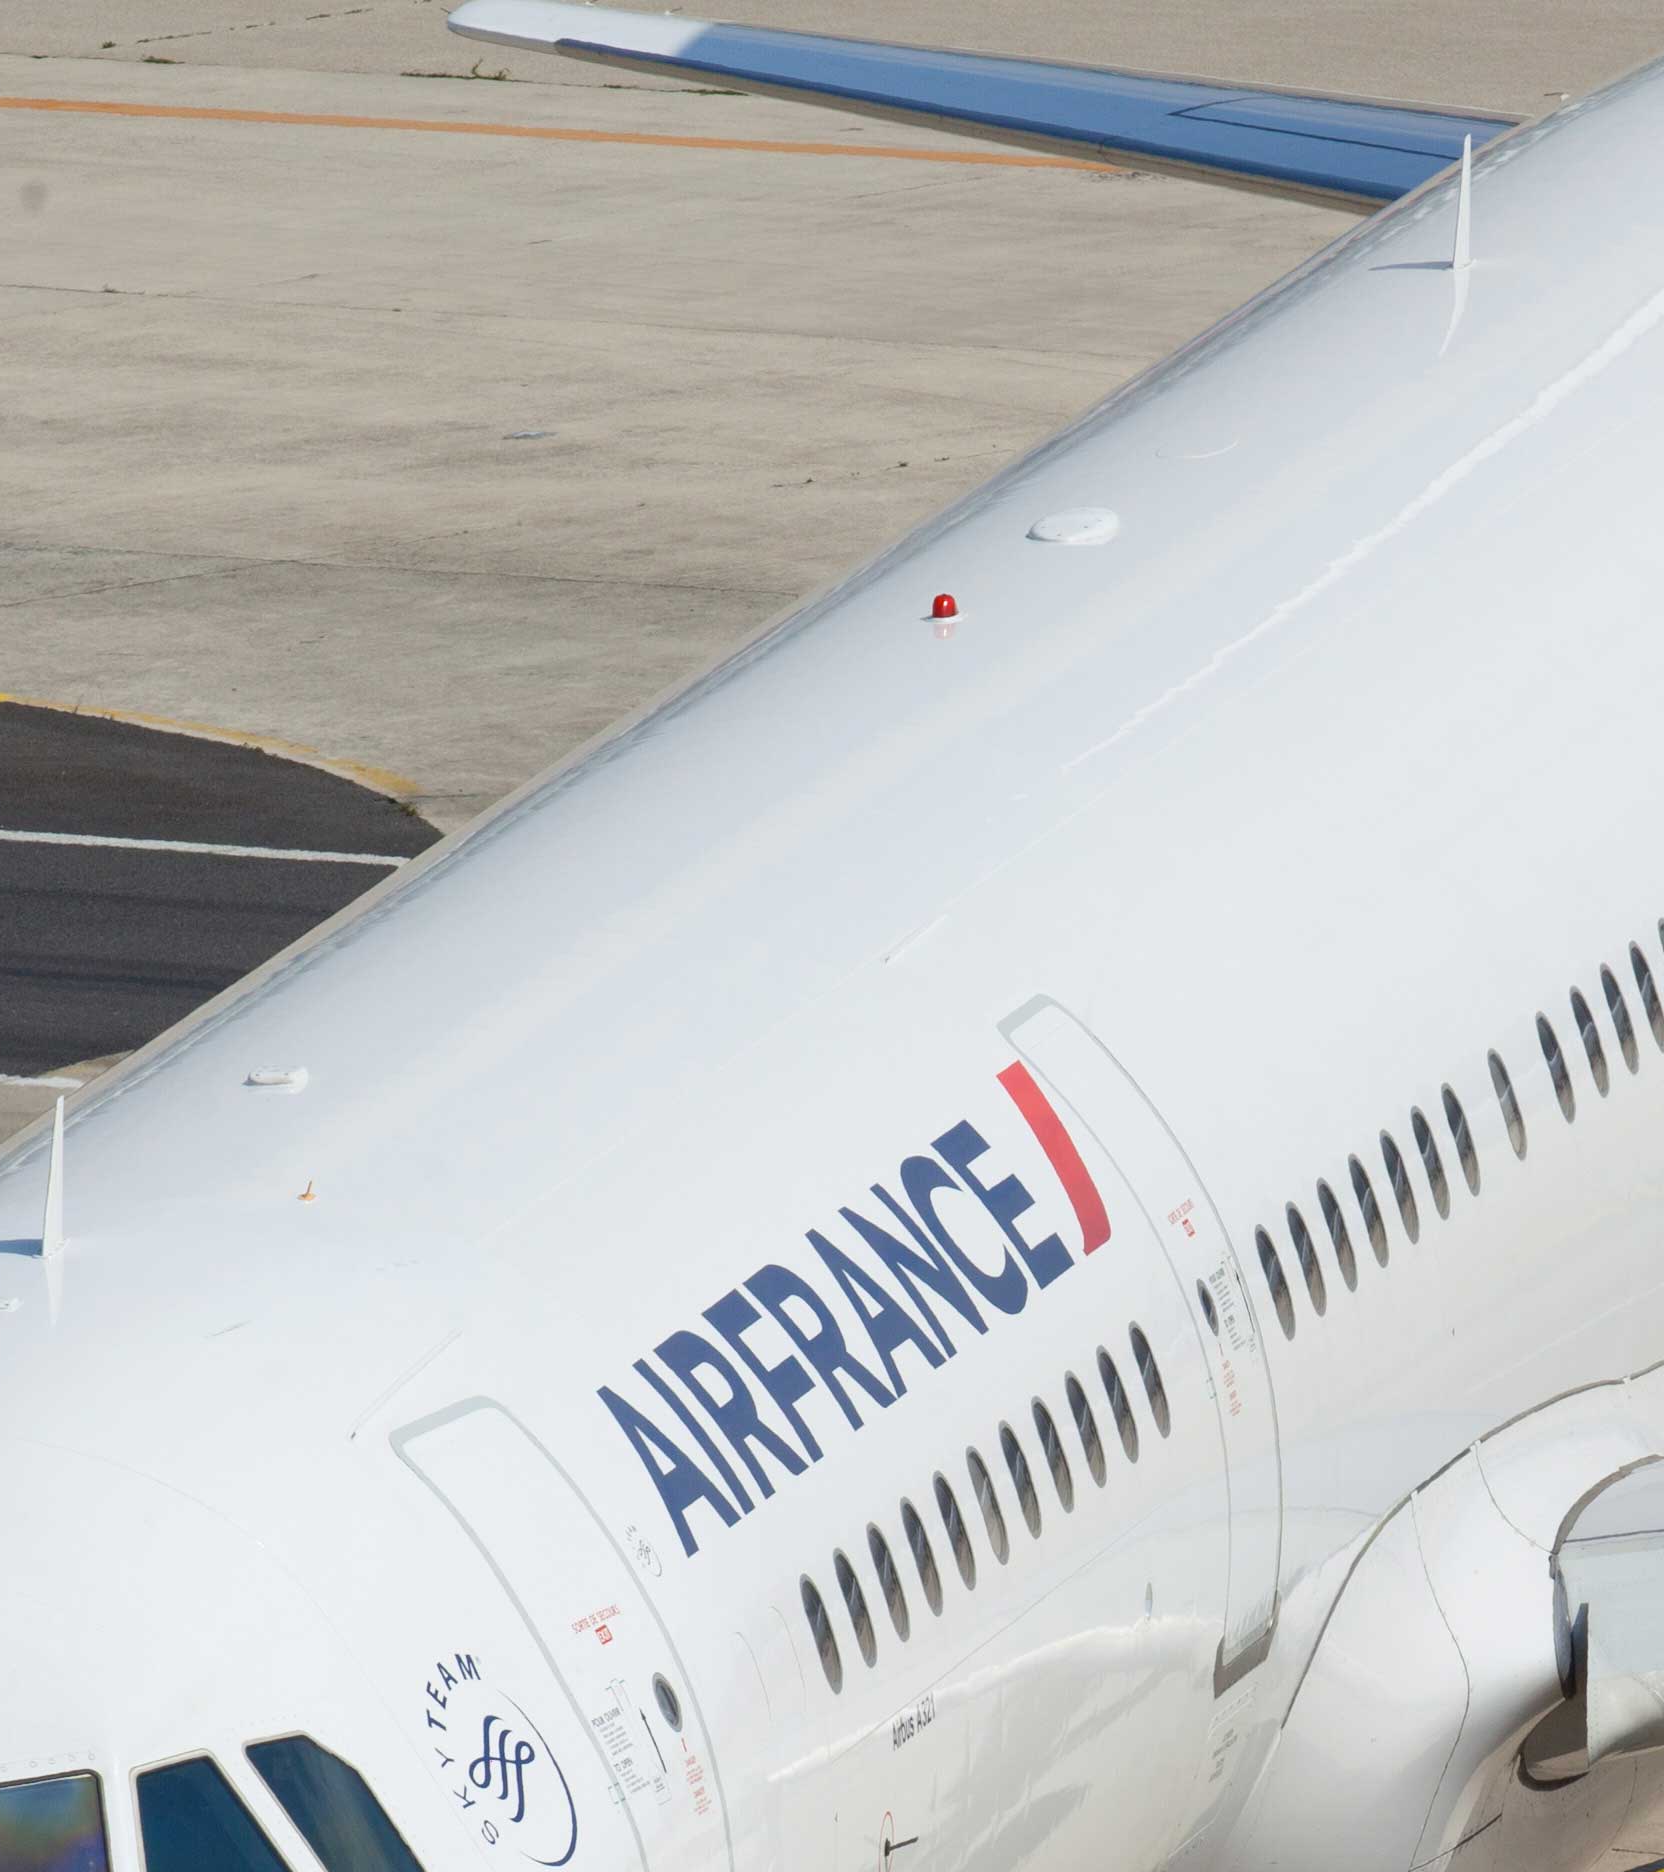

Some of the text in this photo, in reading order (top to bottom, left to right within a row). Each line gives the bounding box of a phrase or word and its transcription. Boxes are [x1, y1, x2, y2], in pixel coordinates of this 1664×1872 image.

[596, 1118, 1075, 1558] AIRFRANCE
[892, 1691, 936, 1752] Airbus A321
